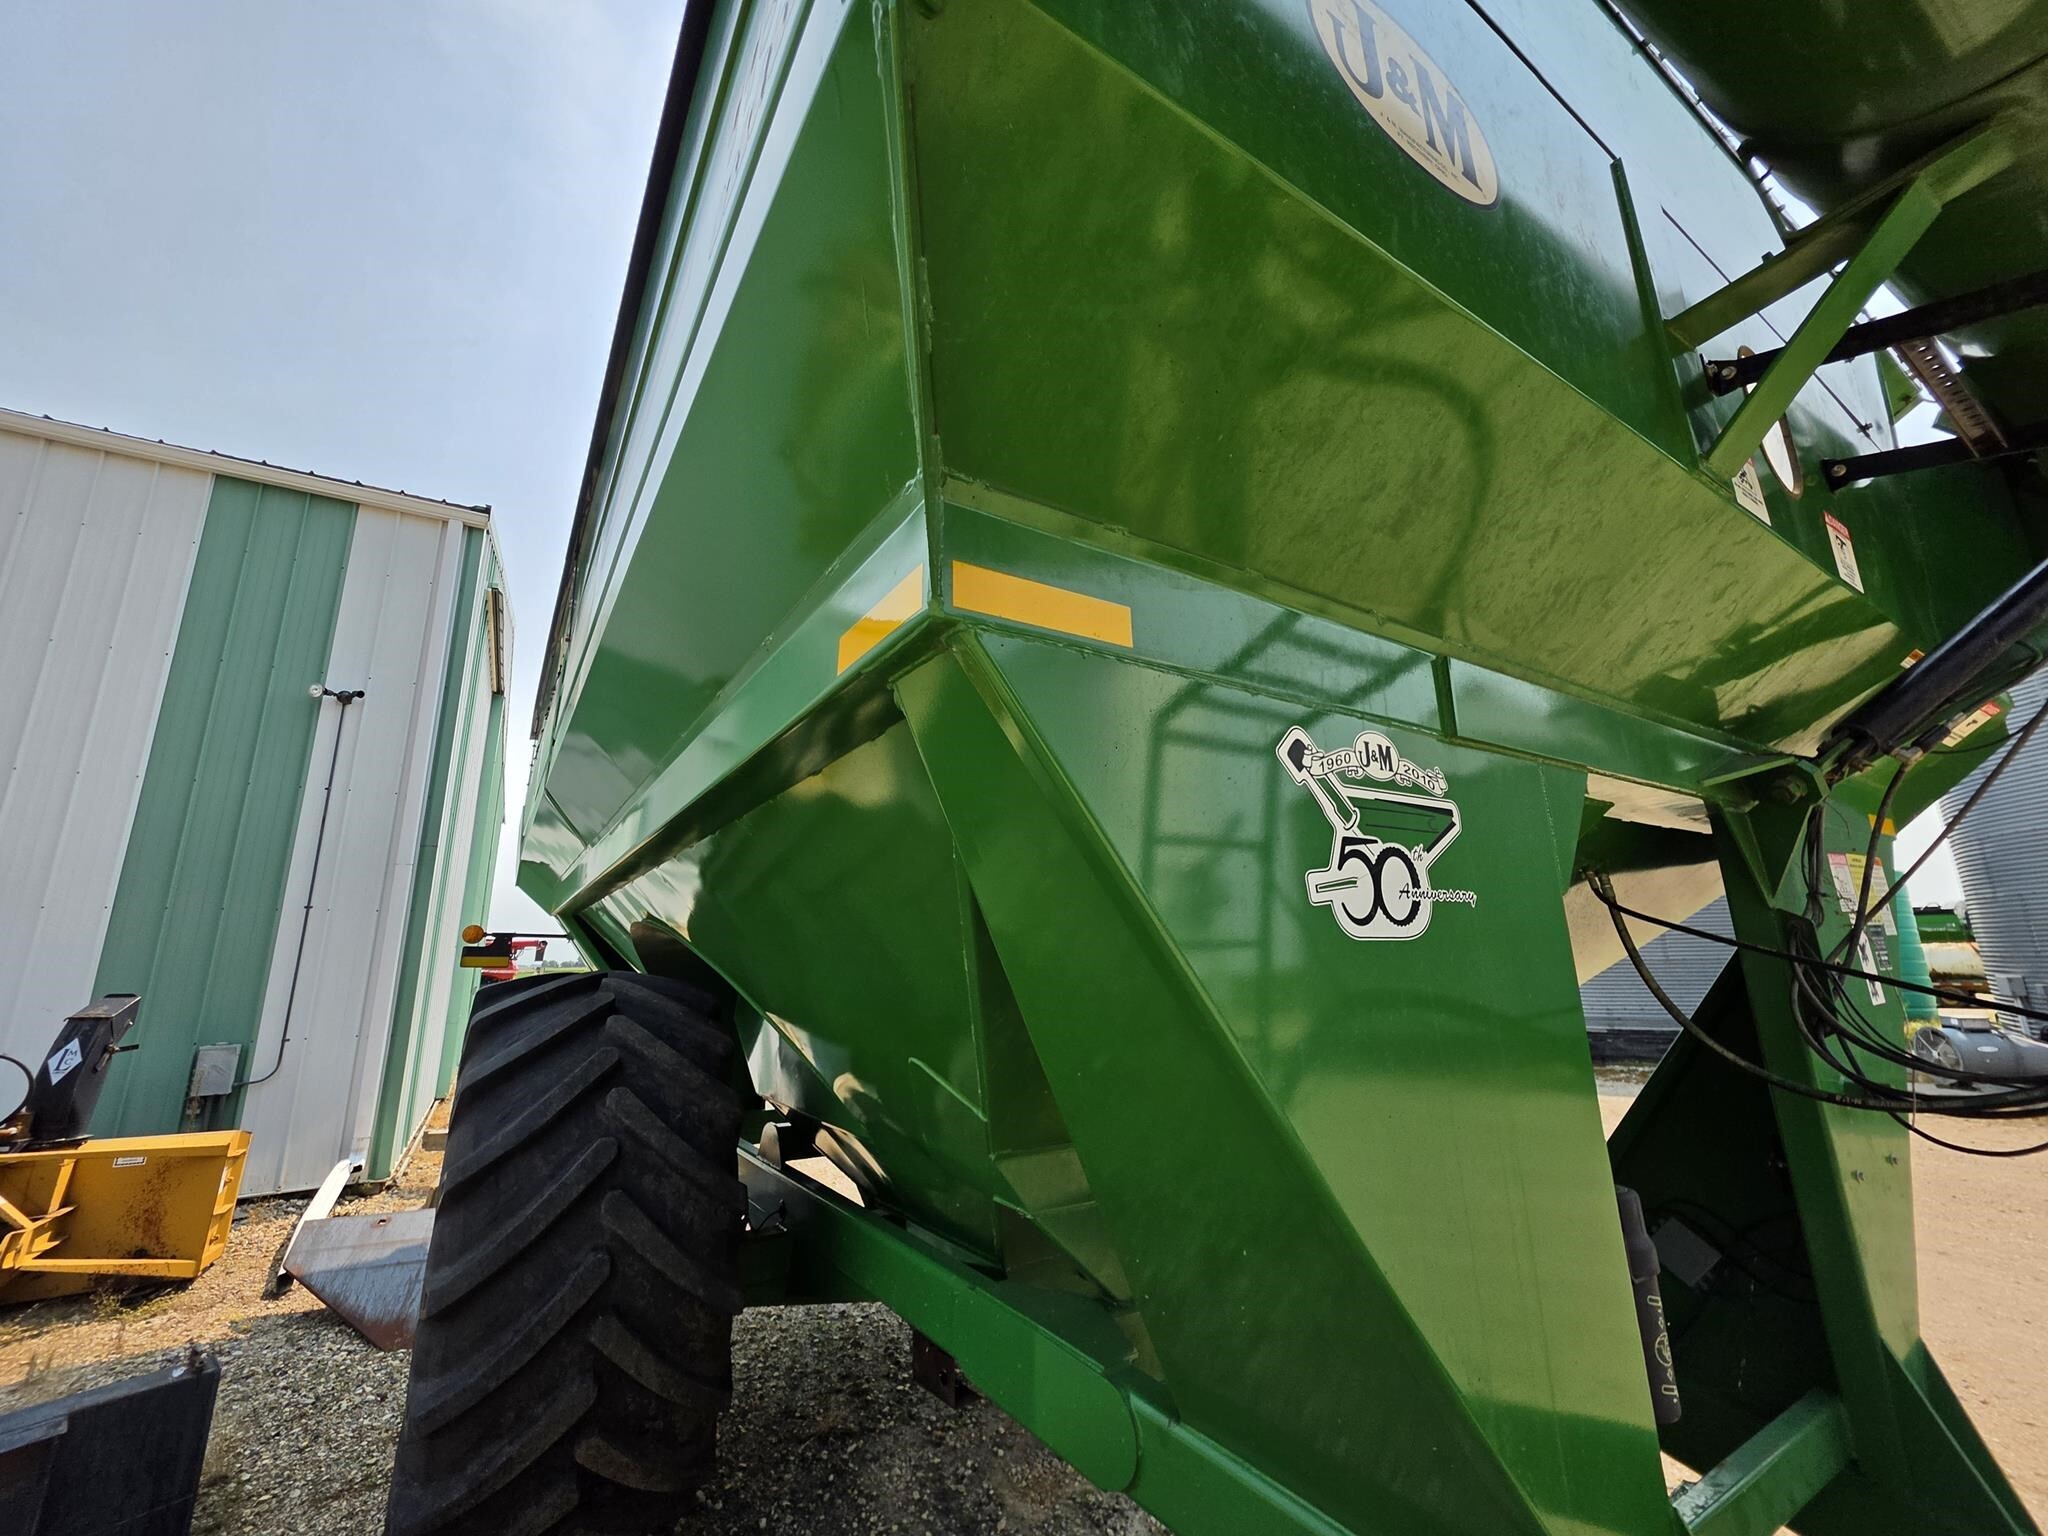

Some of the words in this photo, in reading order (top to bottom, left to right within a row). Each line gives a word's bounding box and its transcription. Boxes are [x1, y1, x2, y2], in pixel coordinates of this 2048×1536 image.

[1325, 0, 1483, 192] J&M
[1318, 752, 1351, 773] 1960
[1358, 741, 1394, 772] J&M
[1403, 763, 1436, 791] 2010
[1338, 836, 1421, 927] 50
[1412, 844, 1424, 862] th
[1399, 882, 1477, 906] Anniversary
